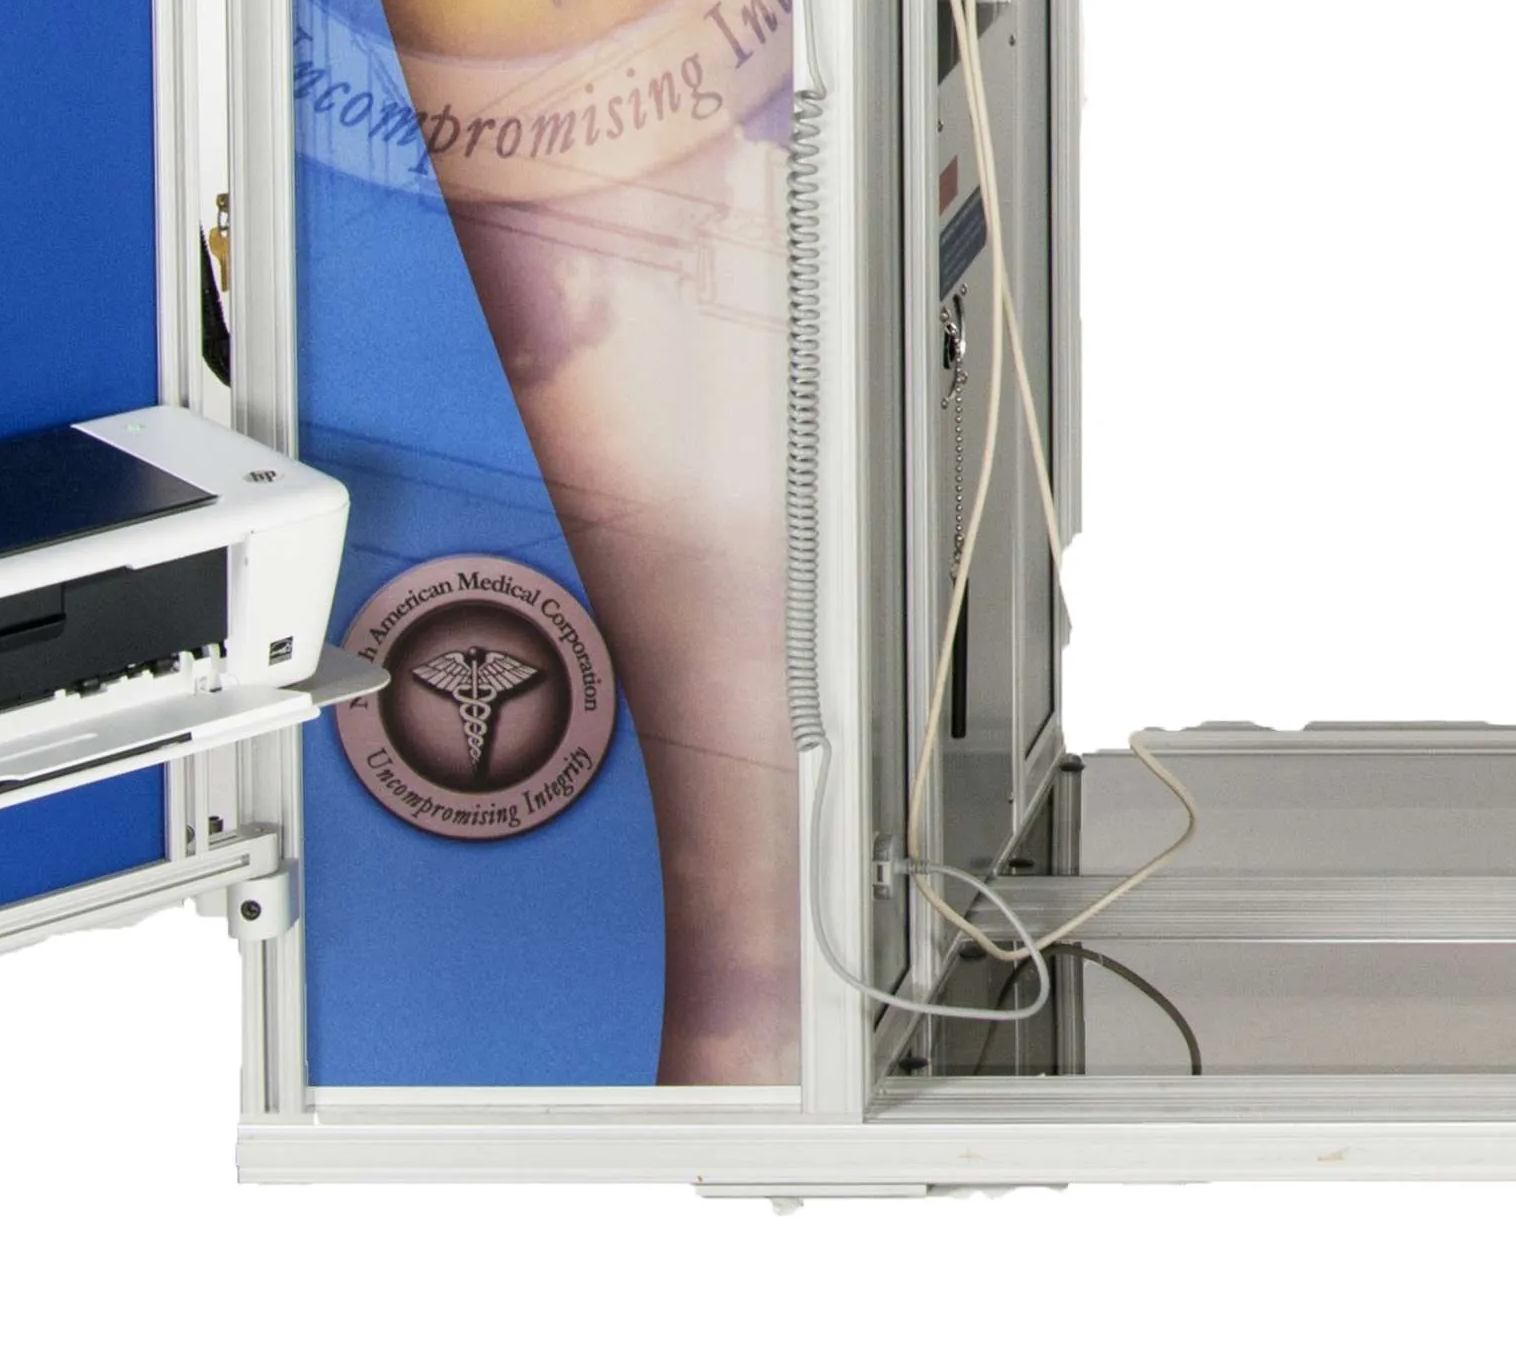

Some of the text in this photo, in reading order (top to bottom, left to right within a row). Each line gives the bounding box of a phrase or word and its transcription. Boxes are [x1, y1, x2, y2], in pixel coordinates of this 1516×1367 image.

[368, 571, 599, 712] American Medical Corporation
[366, 745, 594, 828] Uncompromising Integrity
